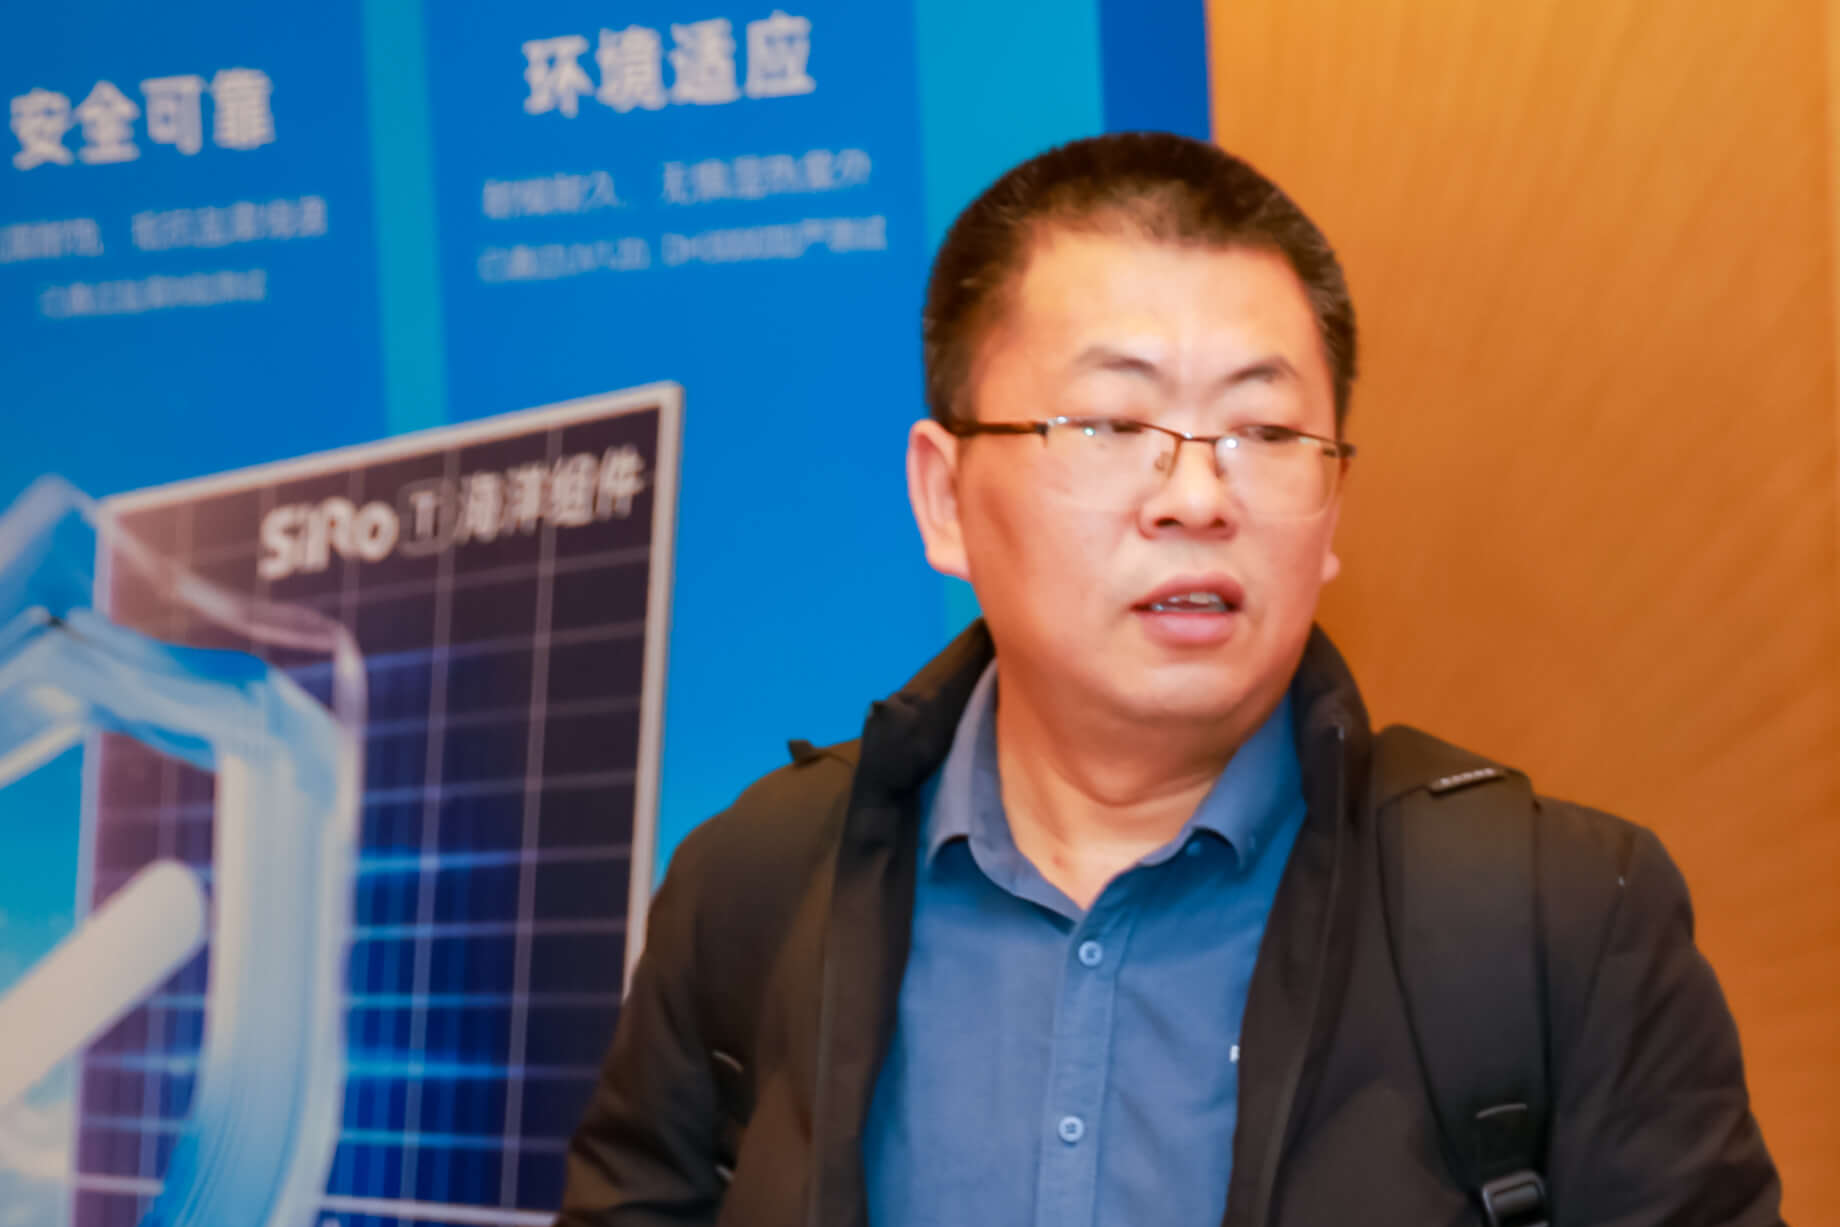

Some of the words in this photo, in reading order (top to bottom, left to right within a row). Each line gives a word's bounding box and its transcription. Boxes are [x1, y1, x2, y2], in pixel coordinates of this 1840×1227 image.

[523, 11, 814, 117] 环境适应
[10, 68, 276, 170] 安全可靠
